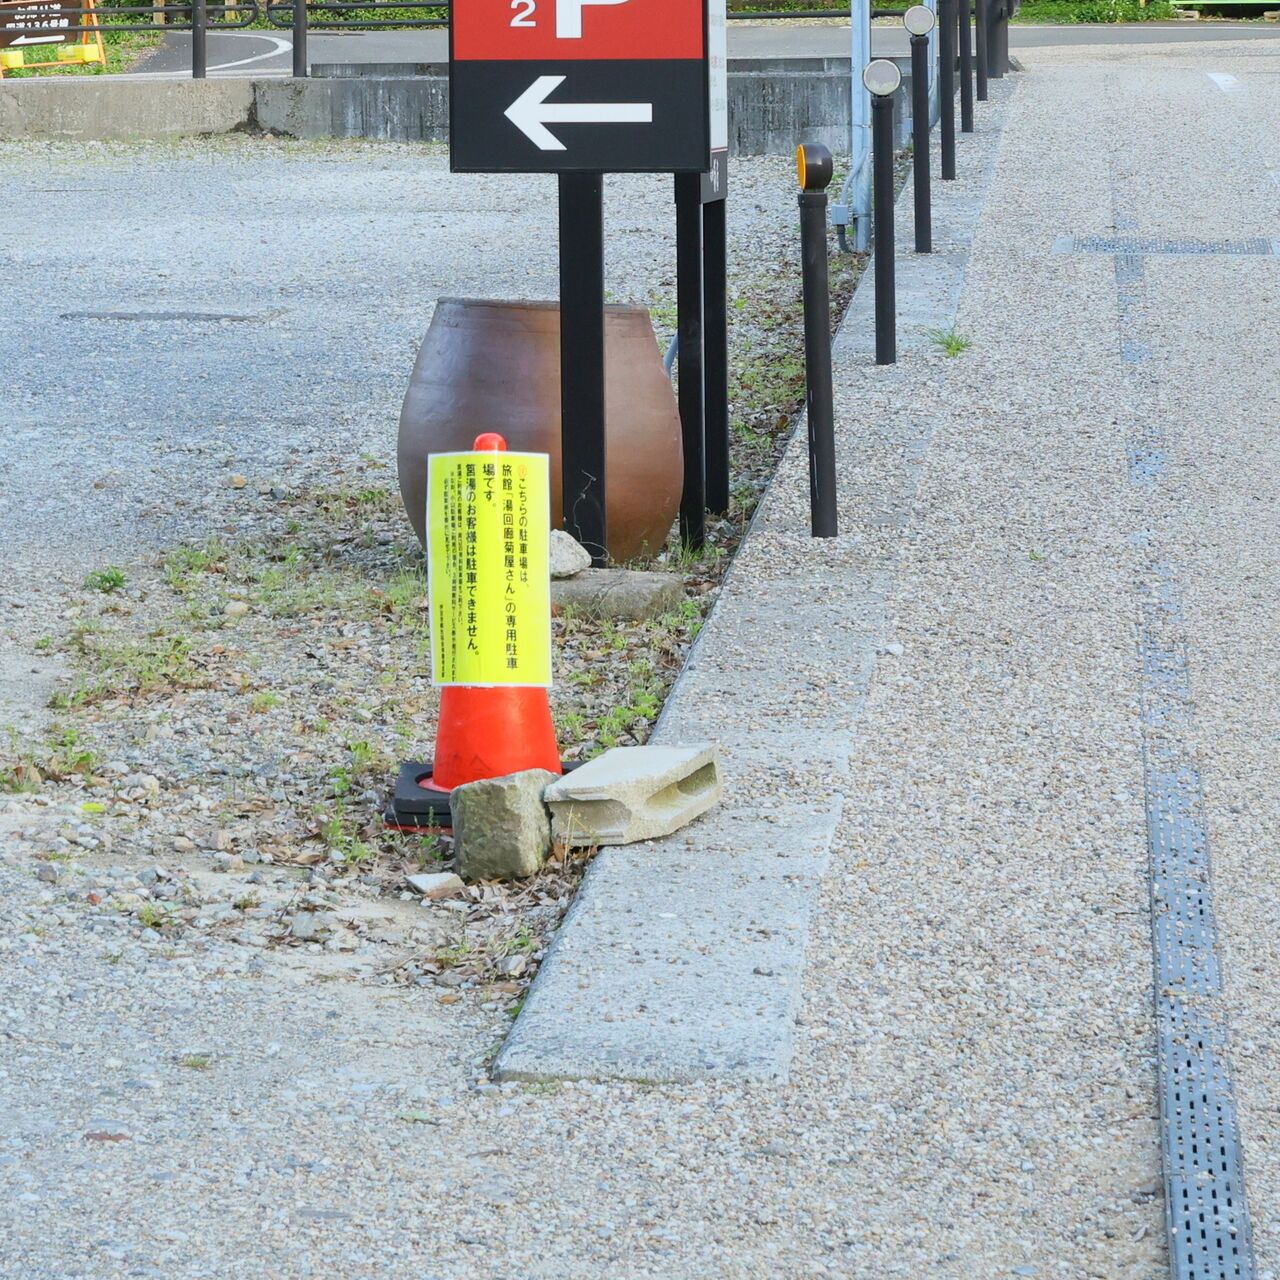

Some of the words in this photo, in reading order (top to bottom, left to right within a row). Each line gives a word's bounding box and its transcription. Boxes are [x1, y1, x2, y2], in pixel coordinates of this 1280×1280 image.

[482, 463, 496, 509] 場です。
[518, 478, 530, 588] こちらの駐車場は、
